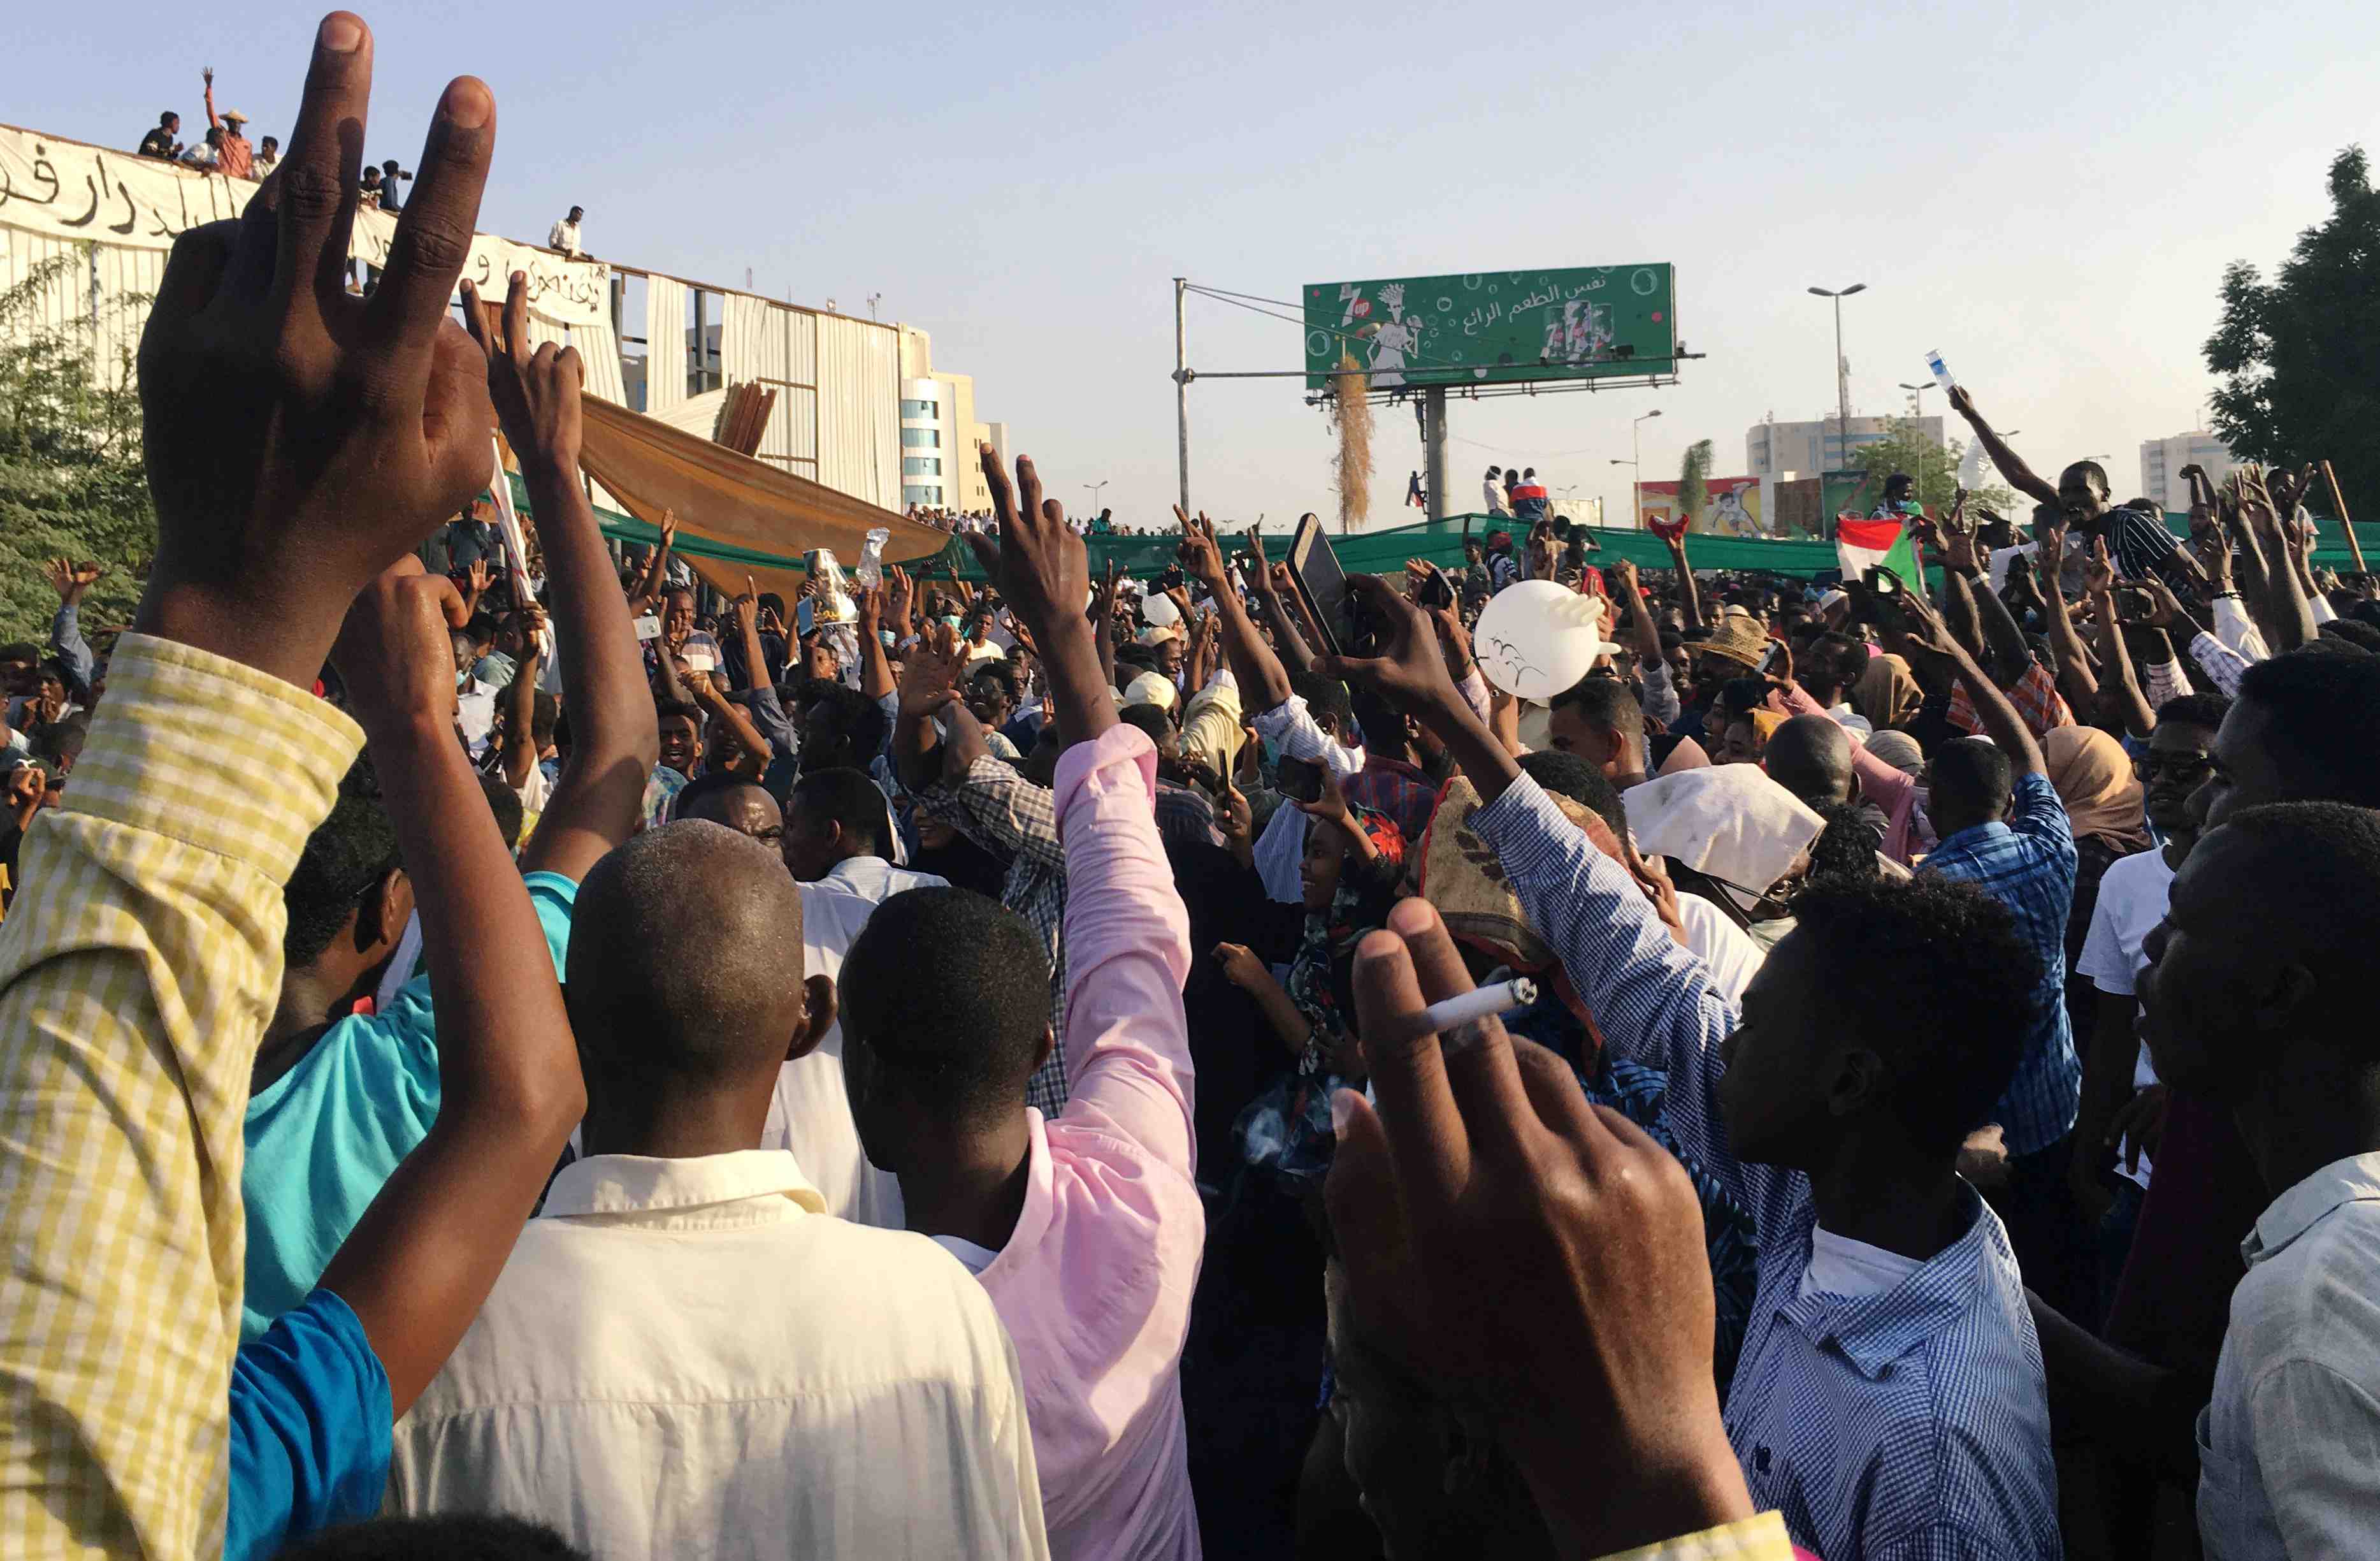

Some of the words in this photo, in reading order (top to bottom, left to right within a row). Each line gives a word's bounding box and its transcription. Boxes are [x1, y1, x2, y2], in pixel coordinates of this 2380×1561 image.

[1508, 284, 1561, 323] الطعم
[1565, 275, 1606, 300] نفس
[1463, 301, 1502, 336] الرائع
